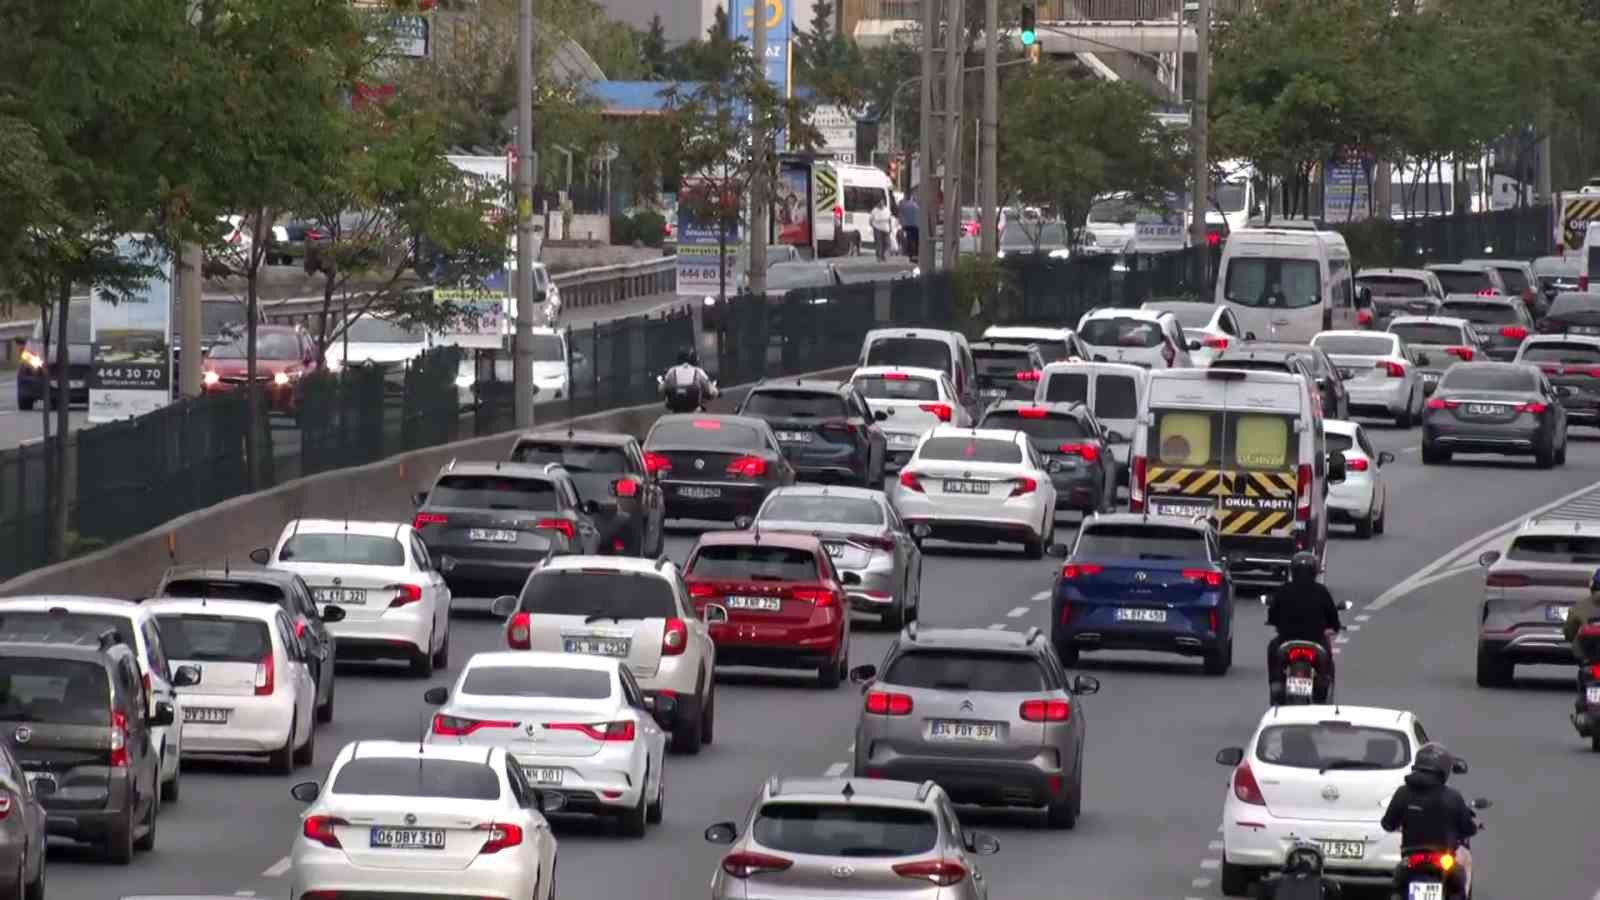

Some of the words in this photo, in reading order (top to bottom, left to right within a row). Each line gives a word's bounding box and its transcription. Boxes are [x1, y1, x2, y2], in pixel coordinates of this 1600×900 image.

[680, 268, 699, 279] 444
[97, 368, 121, 378] 444
[126, 368, 142, 379] 30
[144, 369, 161, 379] 70
[1225, 498, 1255, 507] OKUL
[976, 724, 993, 735] 397
[378, 830, 393, 842] 06
[420, 830, 443, 844] 310
